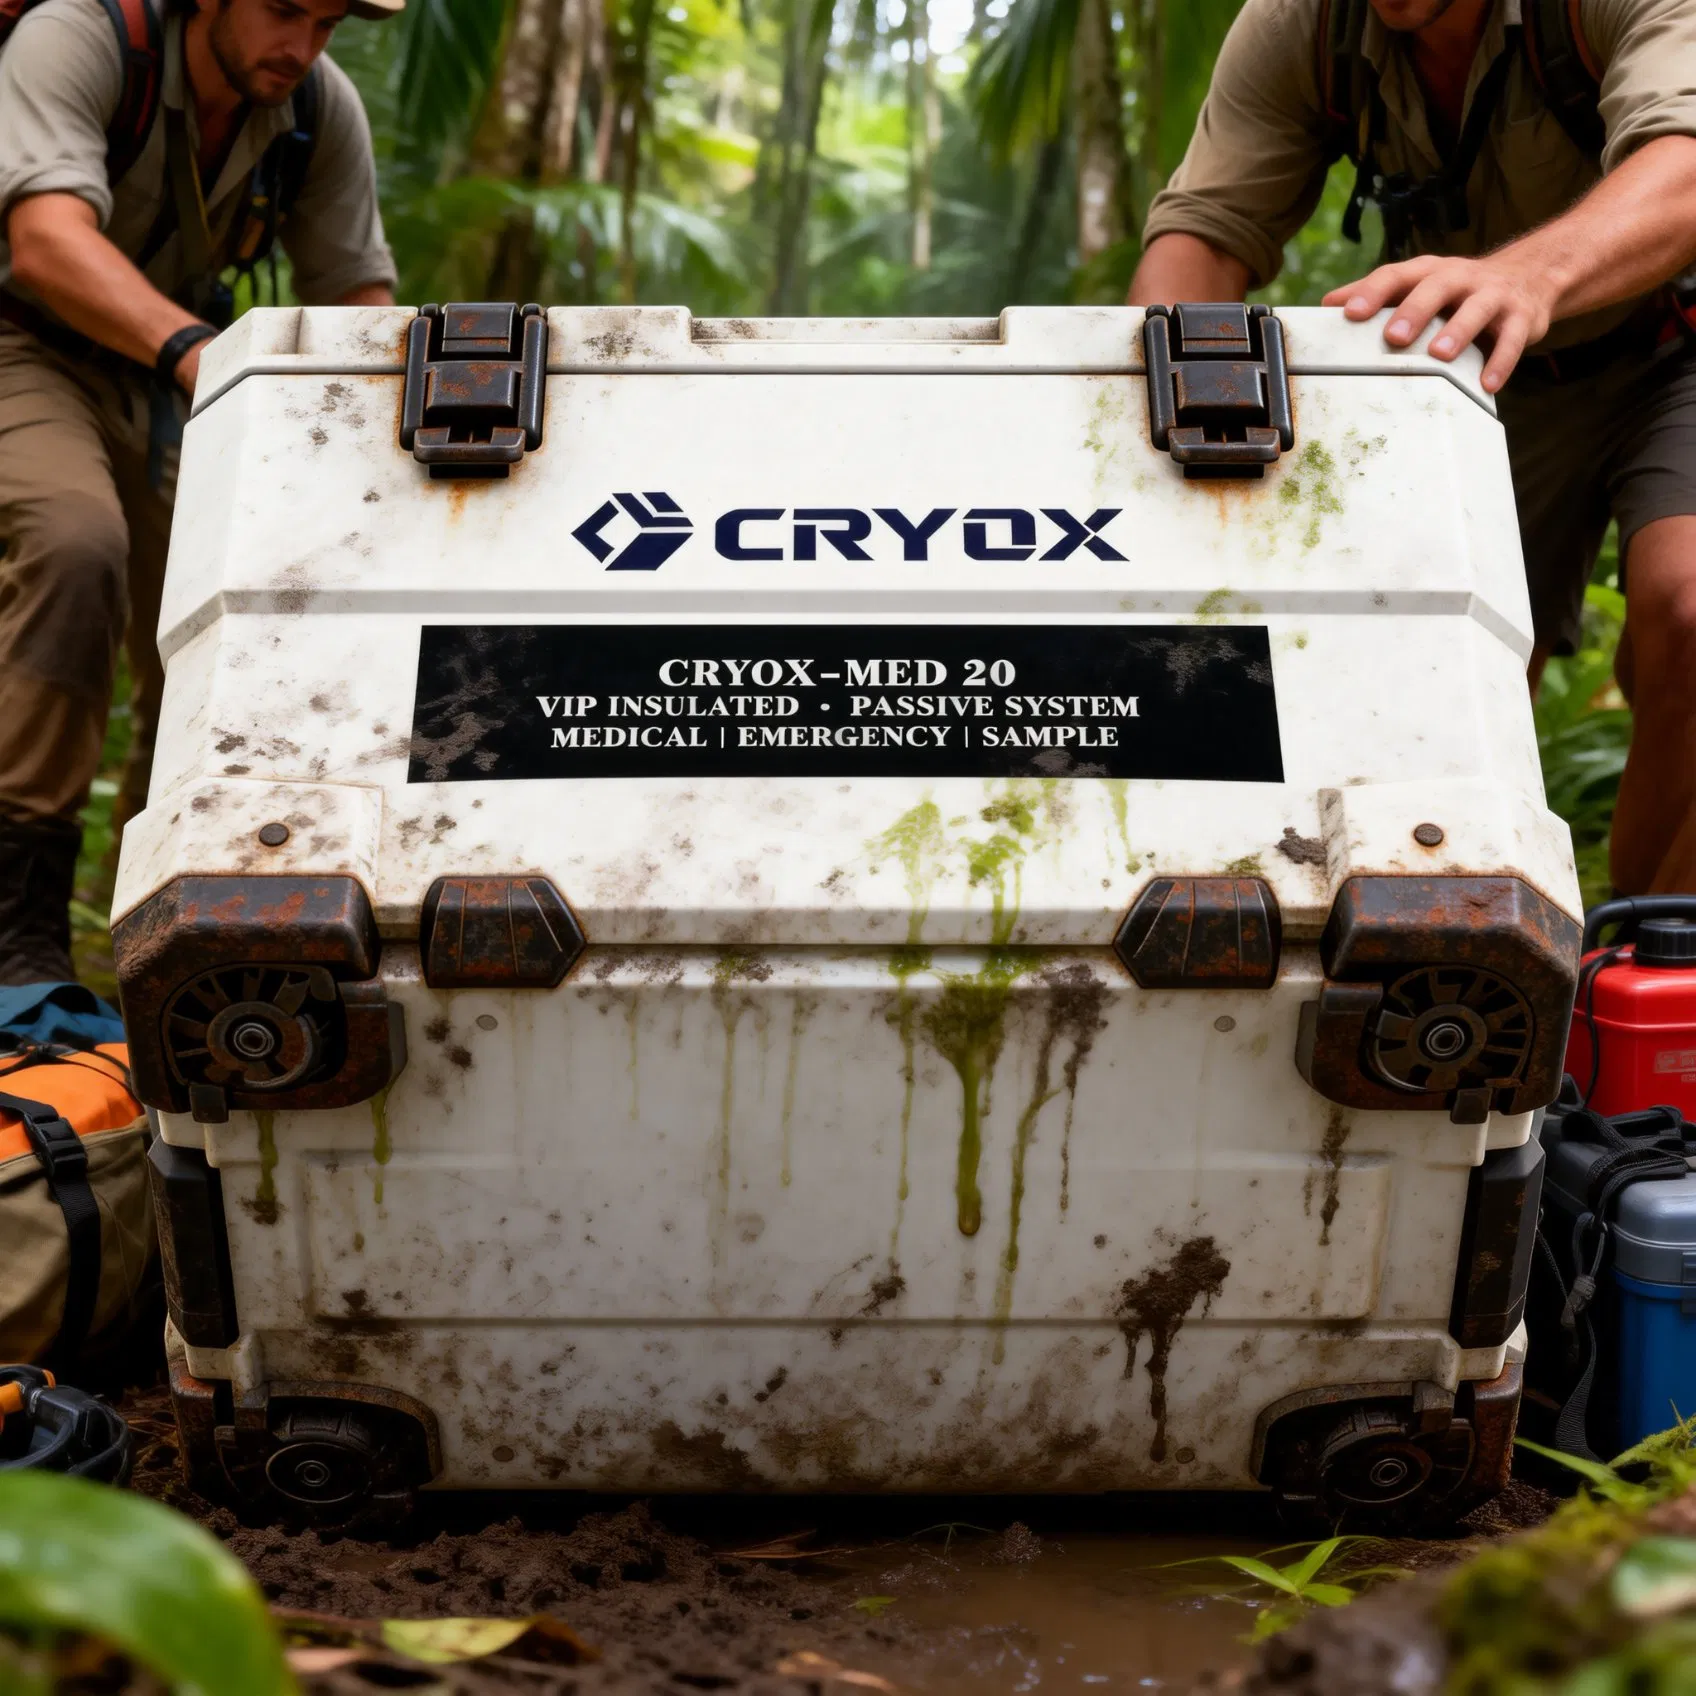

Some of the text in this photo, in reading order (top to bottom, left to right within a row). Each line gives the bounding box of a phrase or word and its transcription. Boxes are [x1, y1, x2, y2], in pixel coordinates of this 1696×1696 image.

[714, 508, 1130, 562] CRYOX
[658, 658, 1016, 687] CRYOX-MED 20
[535, 695, 1140, 718] VIP INSULATED PASSIVE SYSTEM
[550, 726, 1119, 748] MEDICAL EMERGENCY SAMPLE
